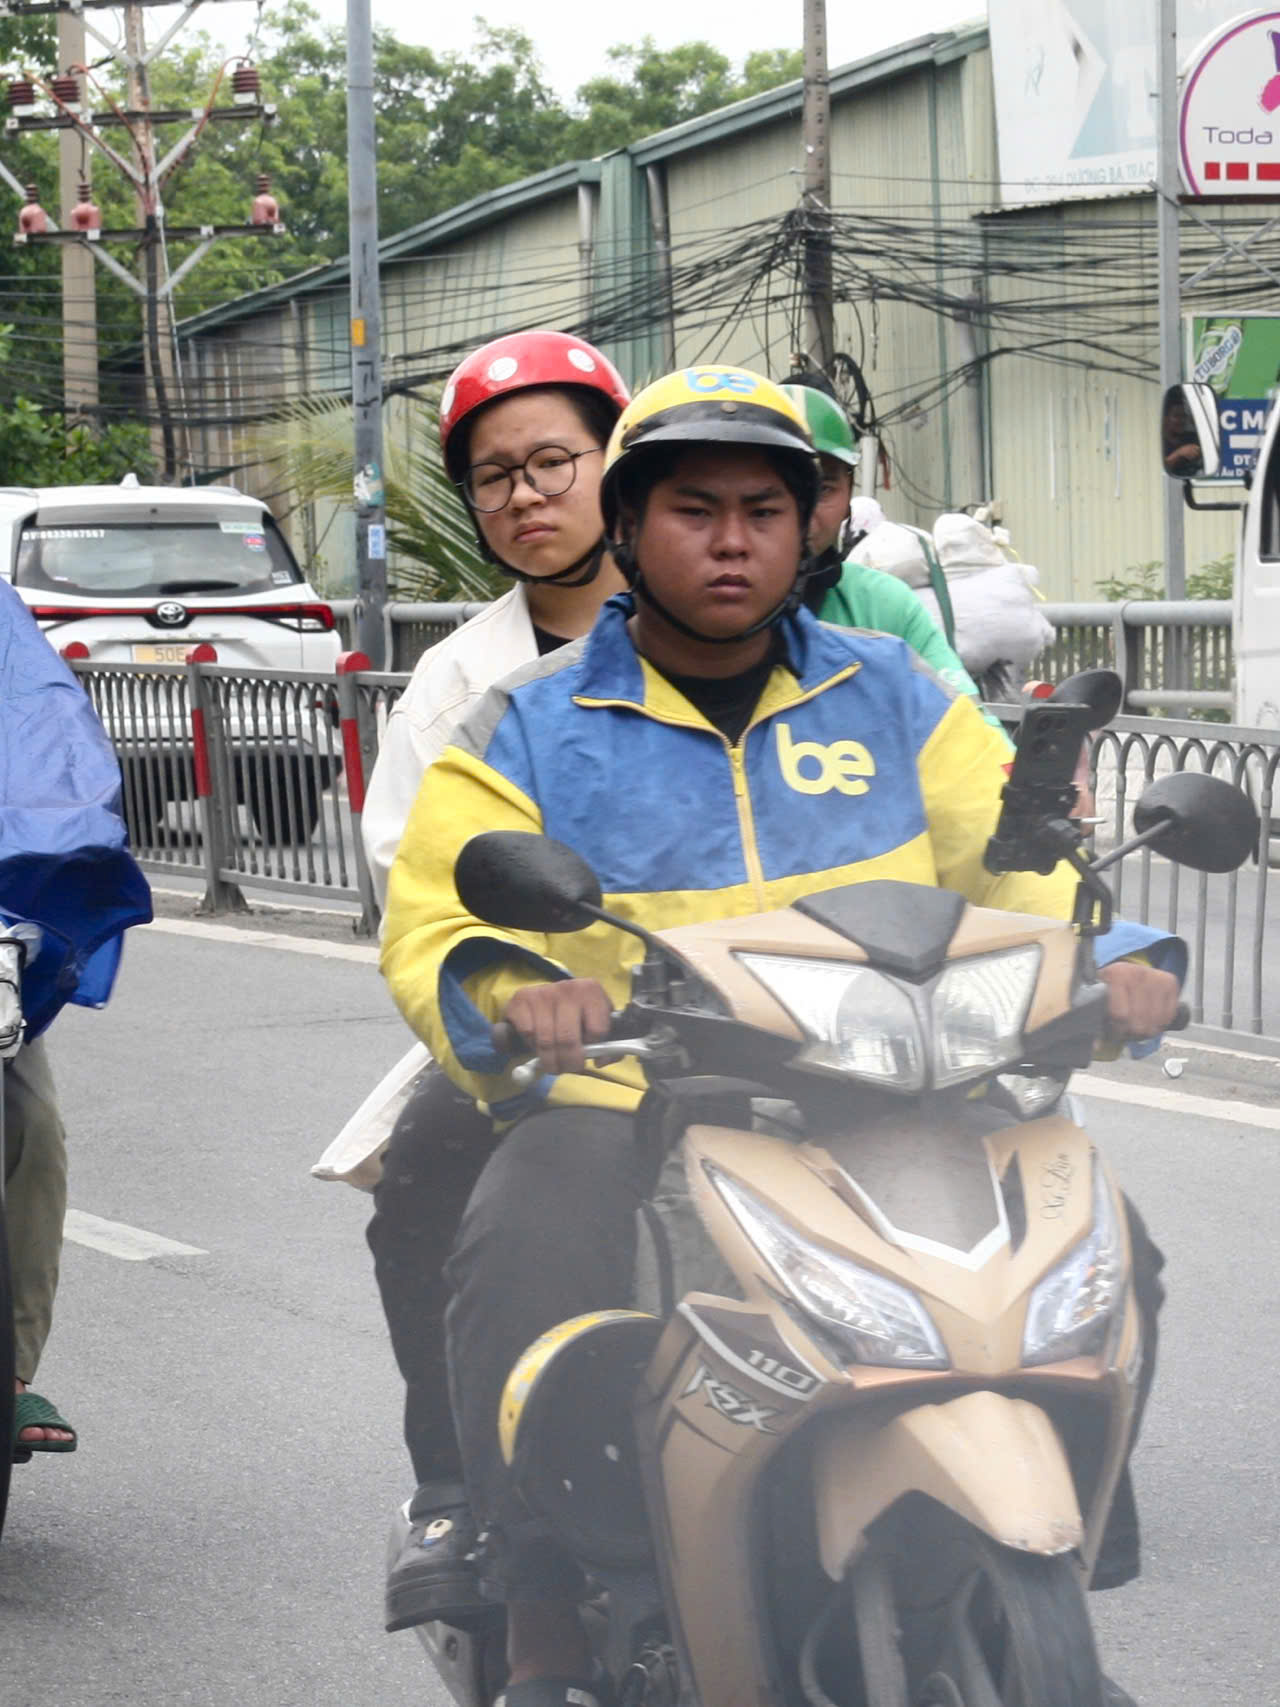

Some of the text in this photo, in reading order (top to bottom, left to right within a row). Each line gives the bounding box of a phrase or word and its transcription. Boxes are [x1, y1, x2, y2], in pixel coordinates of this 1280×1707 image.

[1202, 126, 1273, 145] Toda
[685, 370, 756, 393] be
[154, 646, 185, 662] 50E
[775, 722, 876, 796] be
[747, 1350, 815, 1391] 110
